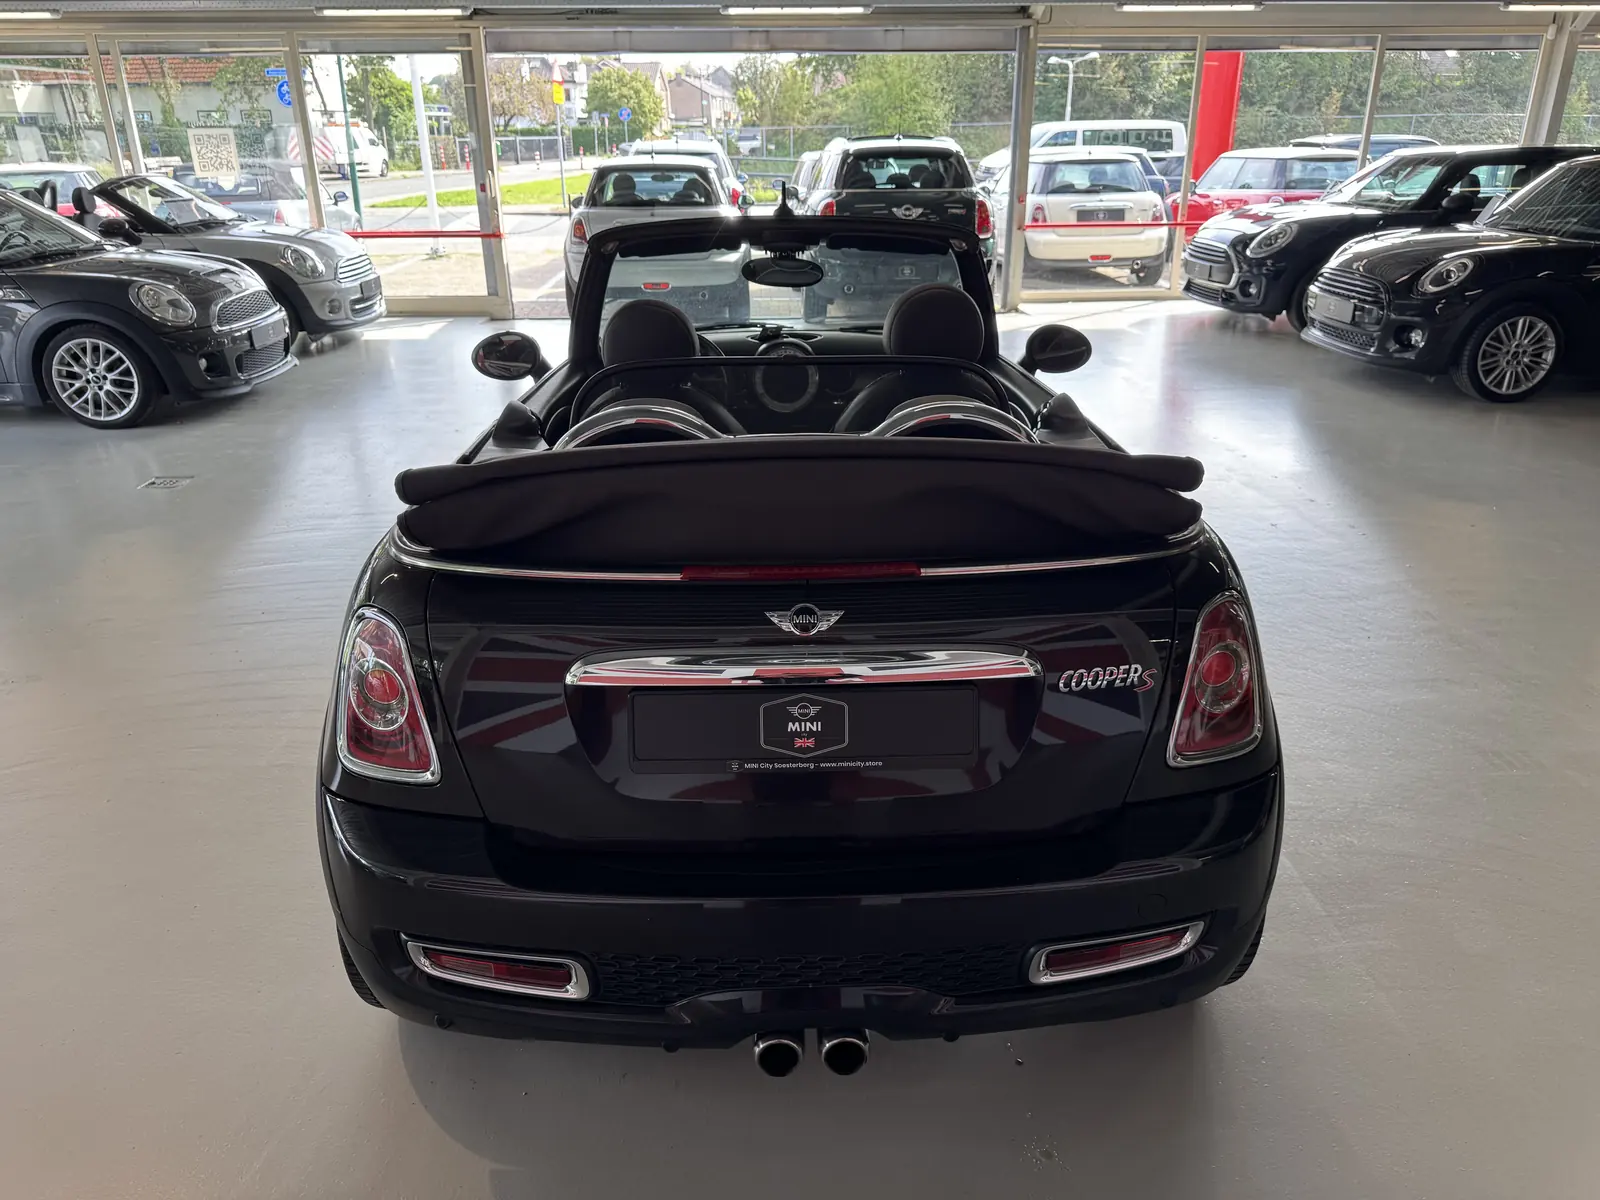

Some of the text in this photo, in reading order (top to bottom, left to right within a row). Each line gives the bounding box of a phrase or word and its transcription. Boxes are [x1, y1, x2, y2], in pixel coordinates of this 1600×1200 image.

[793, 614, 817, 624] MINI
[787, 721, 822, 732] MINI
[759, 762, 773, 770] City
[773, 761, 815, 769] Soesterberg
[819, 760, 883, 768] www.minicity.store
